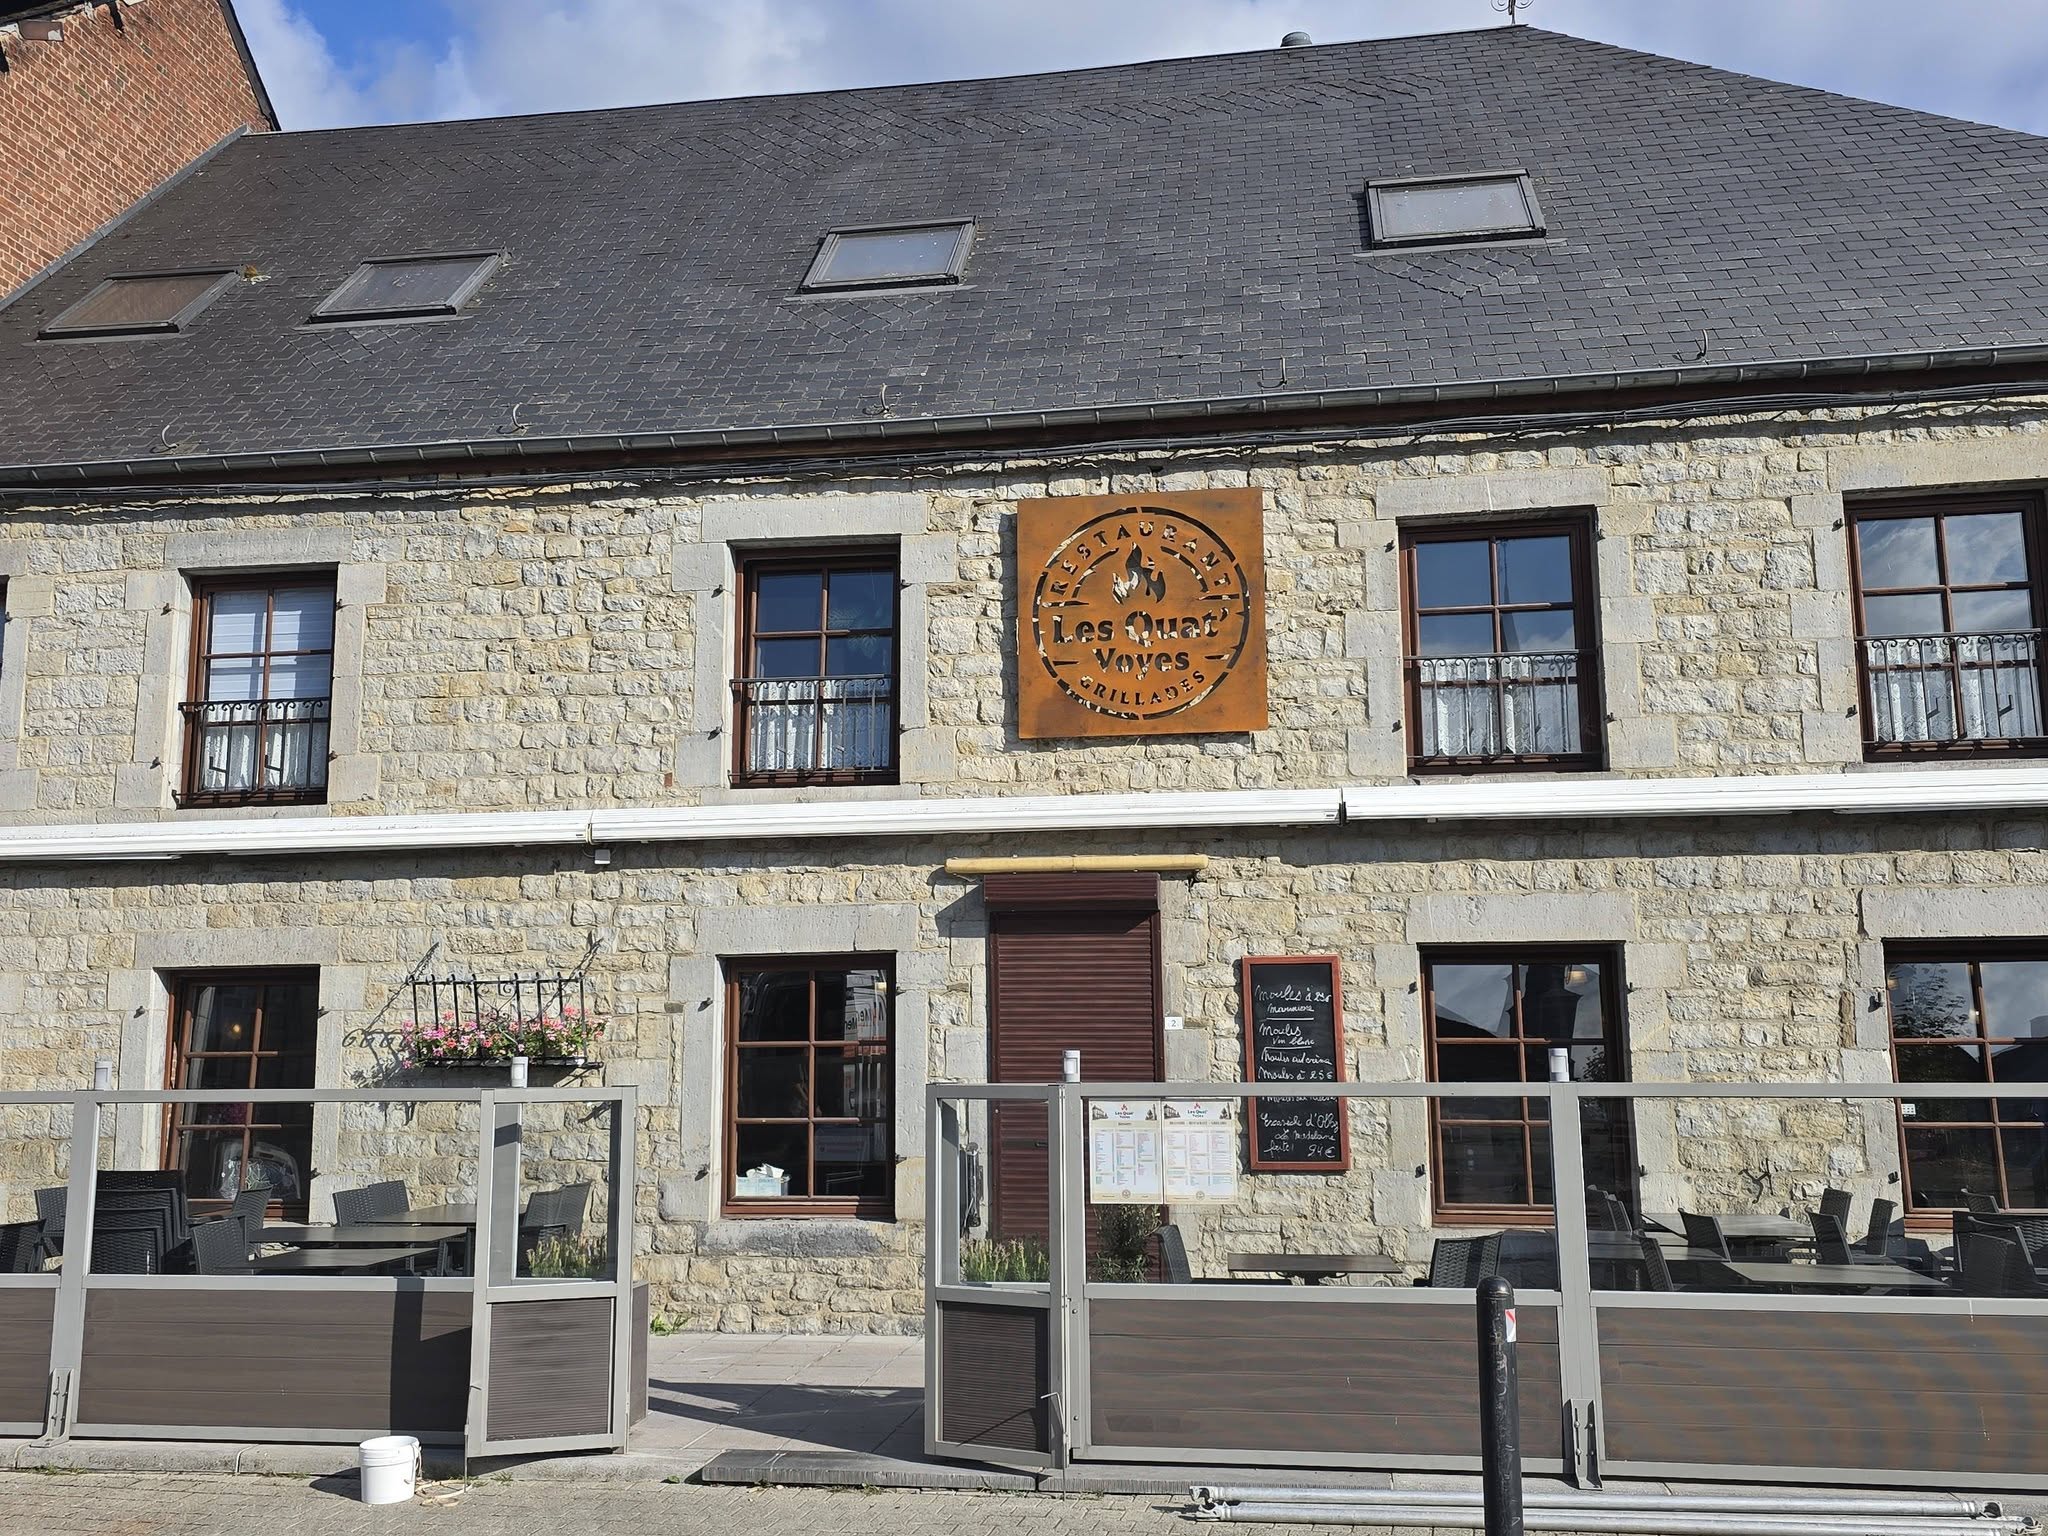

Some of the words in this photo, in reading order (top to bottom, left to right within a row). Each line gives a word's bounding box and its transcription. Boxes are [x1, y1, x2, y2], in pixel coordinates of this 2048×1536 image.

[1050, 520, 1231, 596] RESTAURANT
[1052, 615, 1114, 644] Les
[1125, 607, 1229, 648] Quat'
[1092, 647, 1190, 680] Voyes
[1079, 670, 1205, 706] GRILLADES
[1255, 984, 1302, 1001] Moules
[1171, 1019, 1177, 1027] 2
[1259, 1023, 1301, 1036] Moules
[1258, 1066, 1294, 1080] Moules
